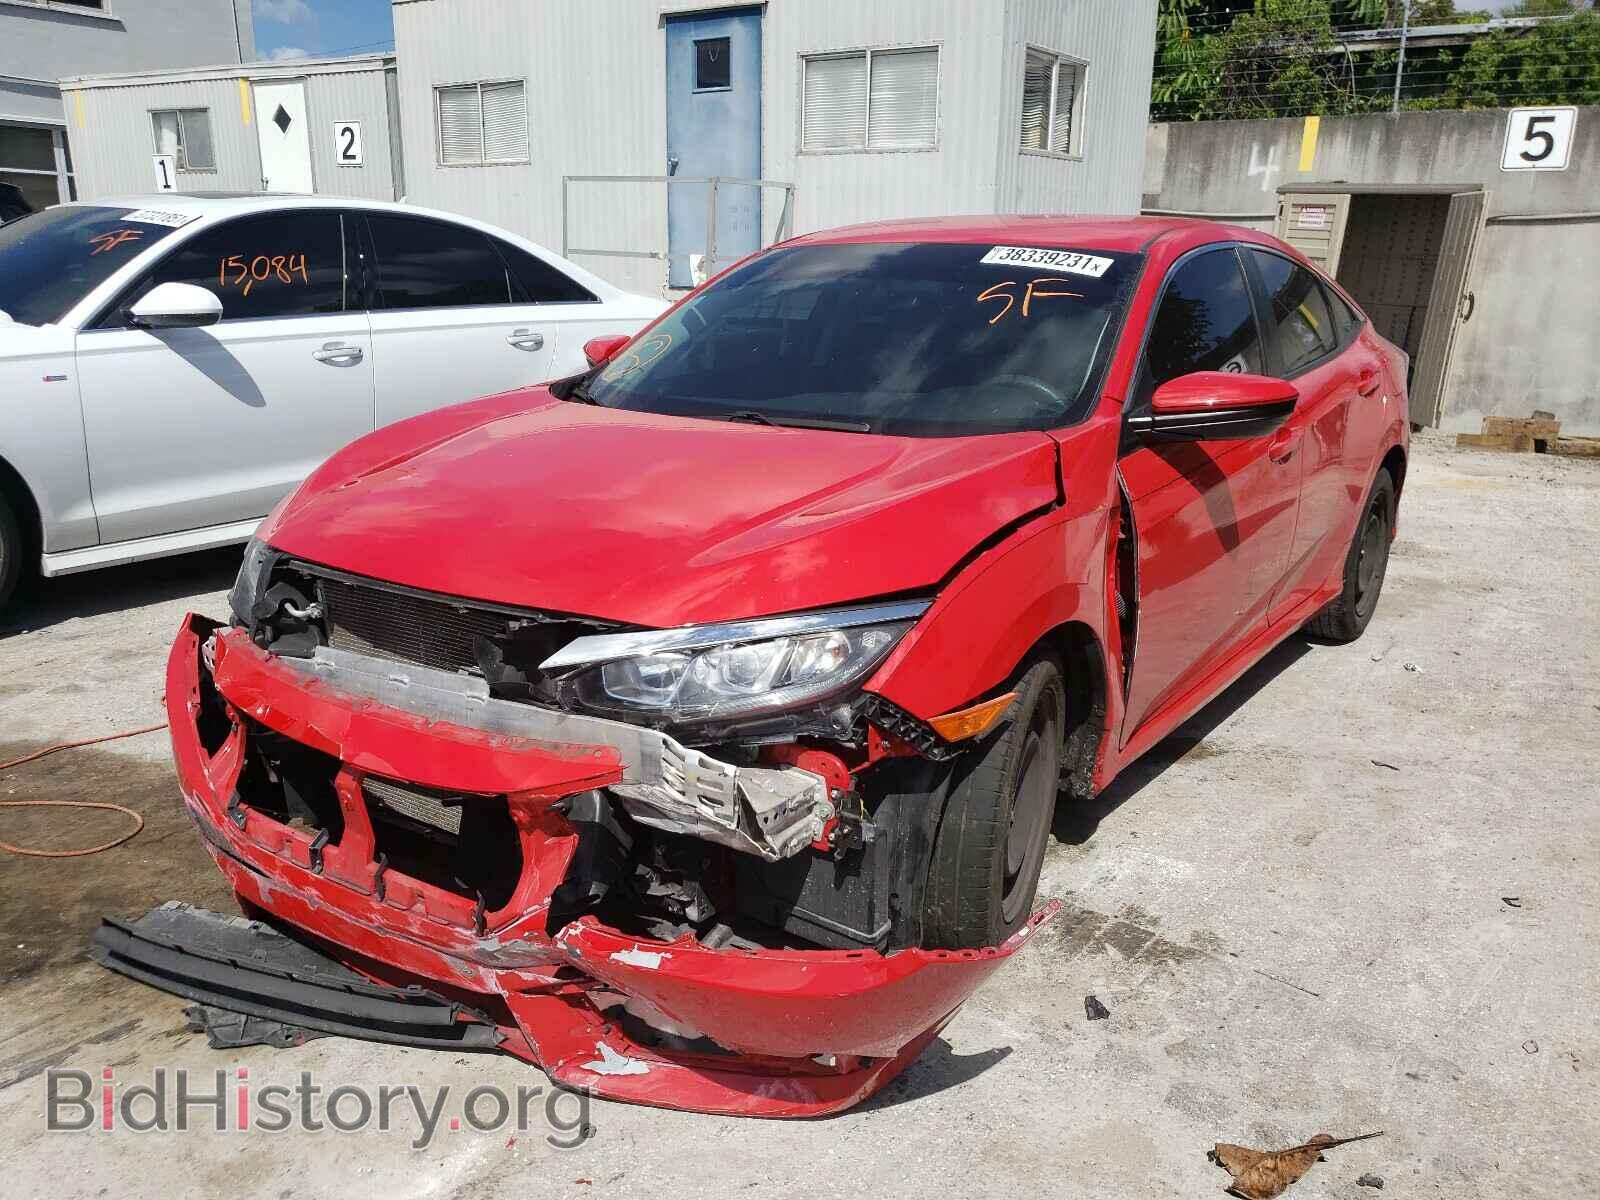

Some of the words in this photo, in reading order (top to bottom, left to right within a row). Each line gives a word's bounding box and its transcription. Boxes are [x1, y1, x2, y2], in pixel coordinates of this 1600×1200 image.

[340, 126, 357, 161] 2
[1519, 115, 1556, 162] 5
[159, 159, 171, 189] 1
[1247, 143, 1281, 192] 4
[88, 227, 144, 256] SF
[999, 248, 1092, 271] 38339231
[220, 254, 309, 297] 15,084
[976, 277, 1086, 325] SF
